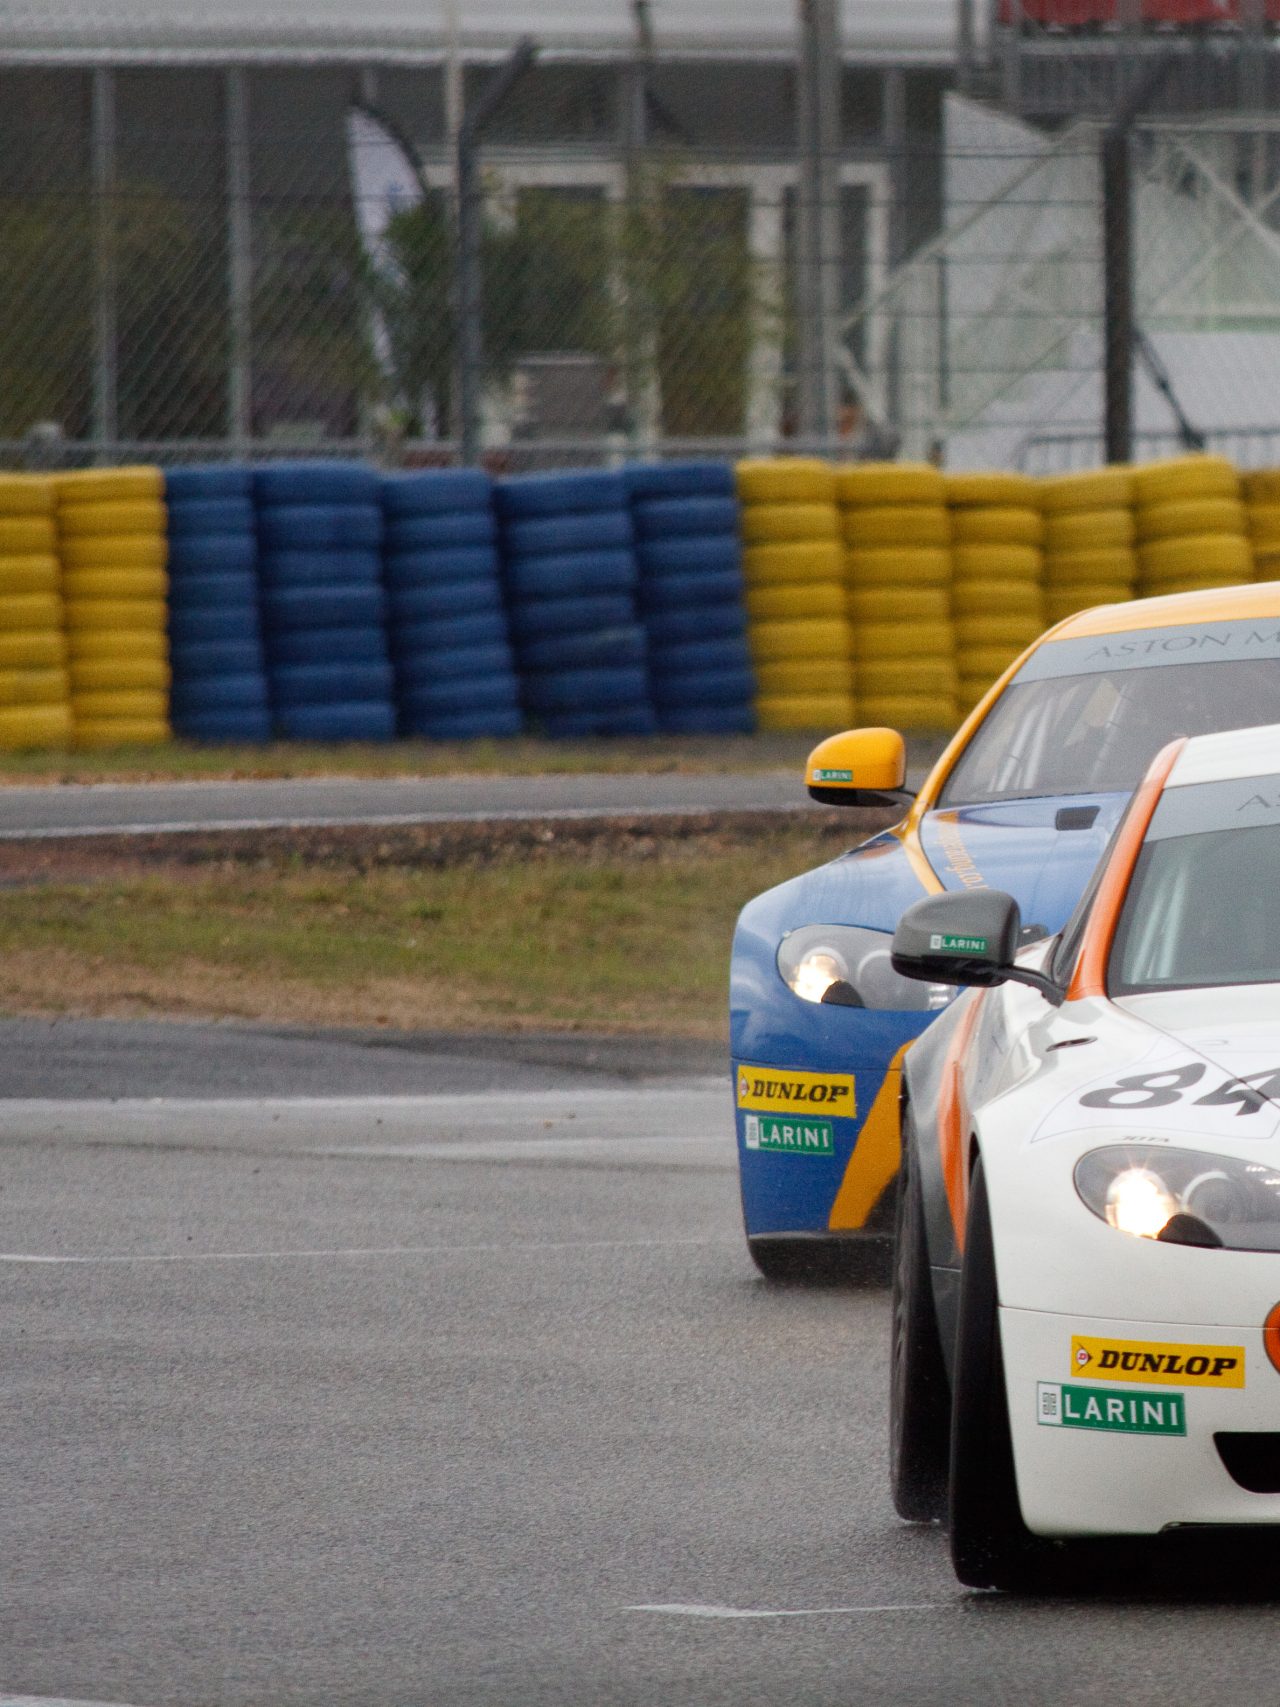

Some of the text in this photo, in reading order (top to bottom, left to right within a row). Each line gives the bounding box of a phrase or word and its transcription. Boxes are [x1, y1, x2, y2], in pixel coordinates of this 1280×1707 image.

[1084, 632, 1232, 661] ASTON
[941, 938, 985, 951] LARINI
[752, 1079, 849, 1103] DUNLOP
[759, 1122, 829, 1148] LARINI
[1097, 1349, 1237, 1377] DUNLOP
[1064, 1393, 1179, 1426] LARINI
